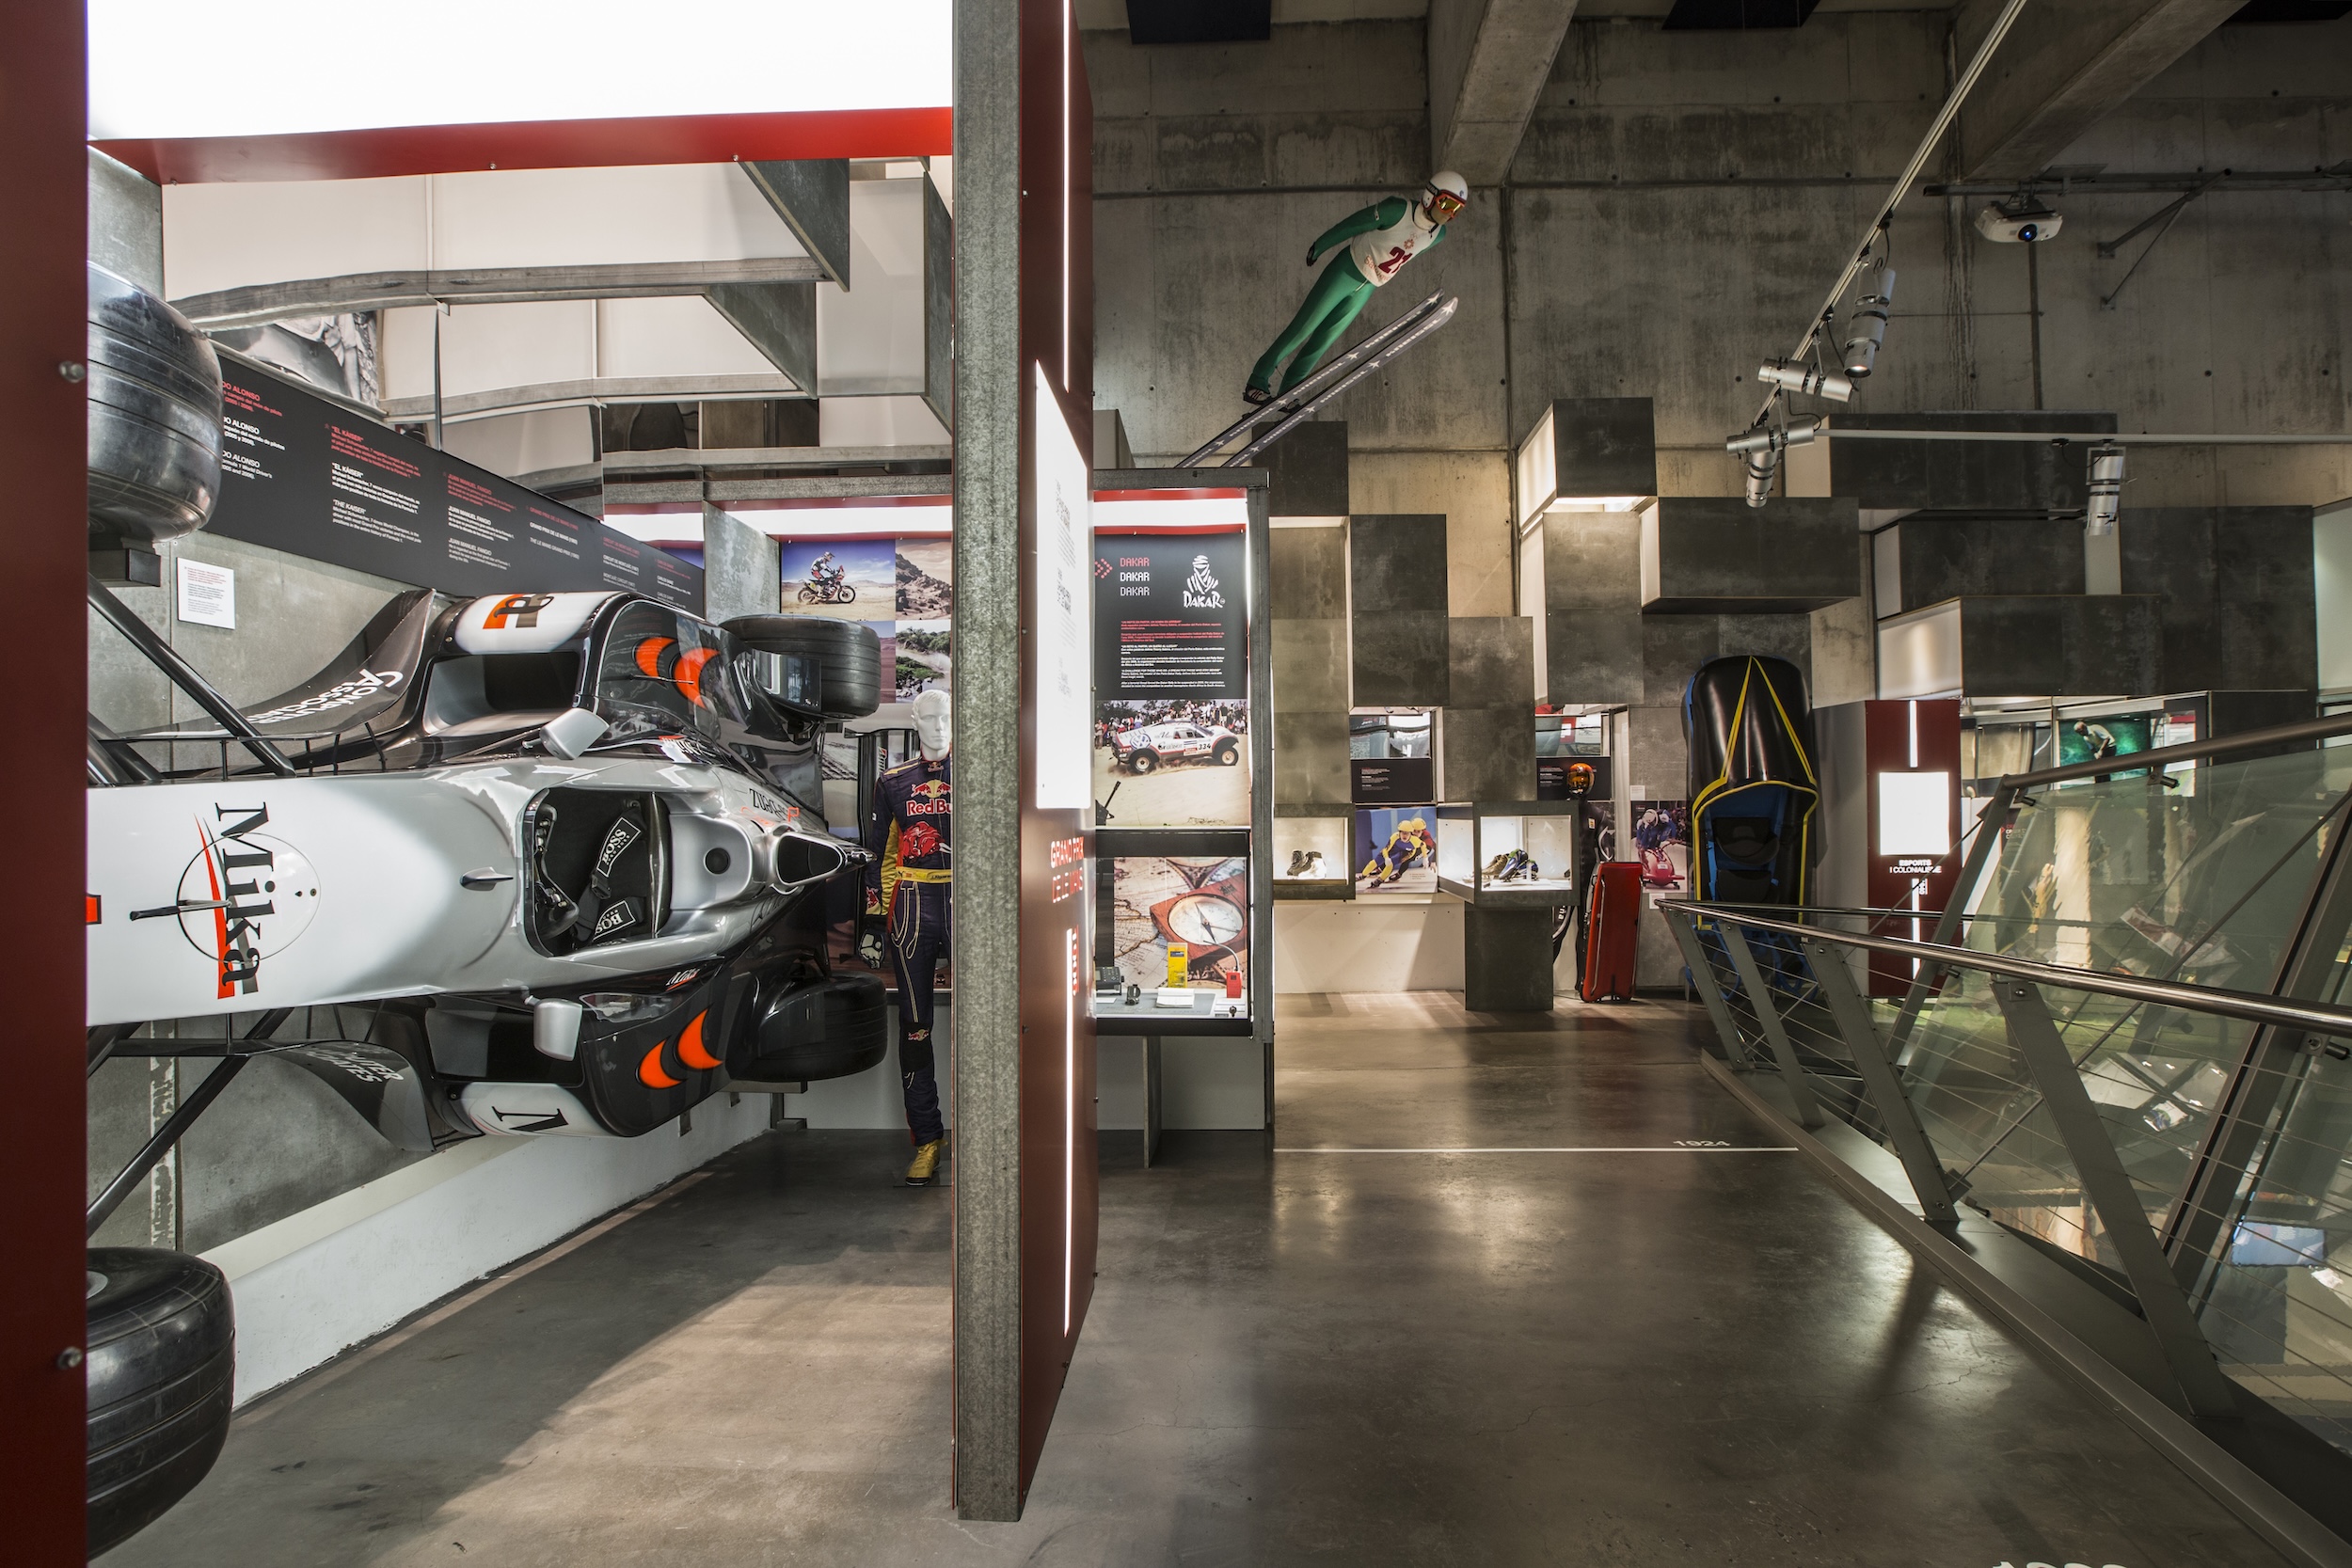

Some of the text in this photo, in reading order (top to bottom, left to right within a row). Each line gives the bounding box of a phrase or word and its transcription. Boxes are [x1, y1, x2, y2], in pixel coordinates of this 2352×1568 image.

[232, 385, 260, 401] ALONSO
[231, 420, 260, 435] ALONSO
[232, 453, 260, 467] ALONSO
[448, 474, 460, 483] JUAN
[448, 506, 460, 515] JUAN
[448, 537, 460, 546] JUAN
[1120, 557, 1150, 567] DAKAR
[1120, 572, 1150, 582] DAKAR
[1120, 586, 1150, 596] DAKAR
[1183, 590, 1223, 609] DAKAR
[906, 800, 933, 816] Red
[602, 829, 628, 864] BOSS
[1050, 836, 1085, 868] GRAND PRIX
[215, 801, 276, 987] Mika
